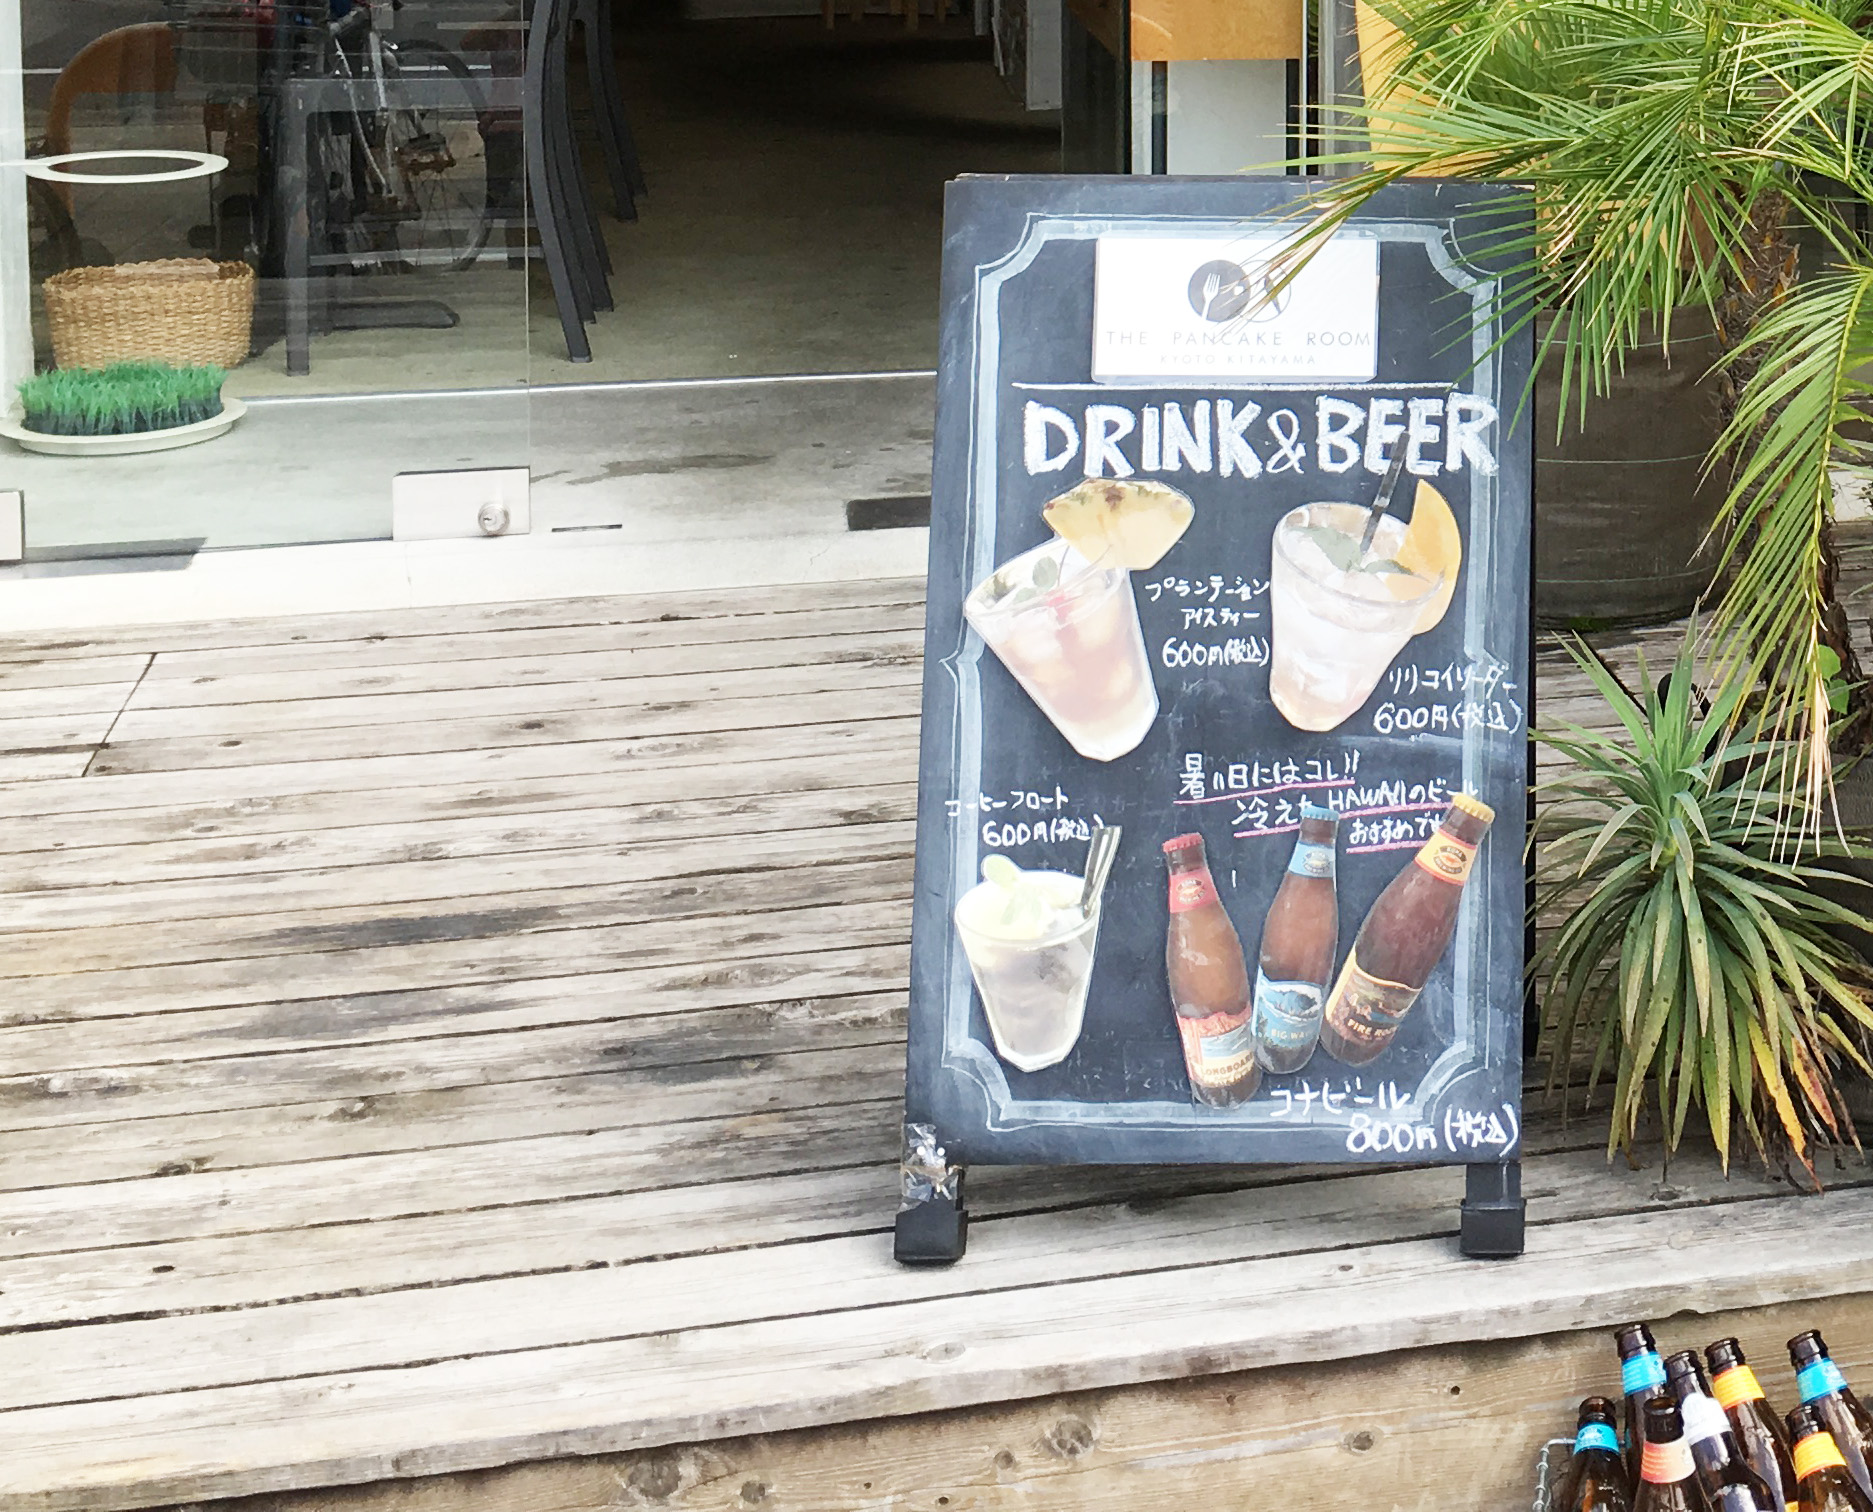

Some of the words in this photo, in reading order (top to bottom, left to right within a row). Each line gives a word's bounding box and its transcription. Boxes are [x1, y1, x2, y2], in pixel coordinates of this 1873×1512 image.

[1106, 331, 1147, 345] THE
[1173, 331, 1282, 346] PANCAKE
[1307, 331, 1370, 346] ROOM
[1160, 354, 1215, 365] KYOTO
[1227, 354, 1316, 365] KITAYAMA
[1180, 607, 1260, 629] アイスティー
[945, 783, 1068, 816] コーヒーフロート
[1271, 1029, 1287, 1040] BIG
[1270, 1076, 1411, 1116] コナビール
